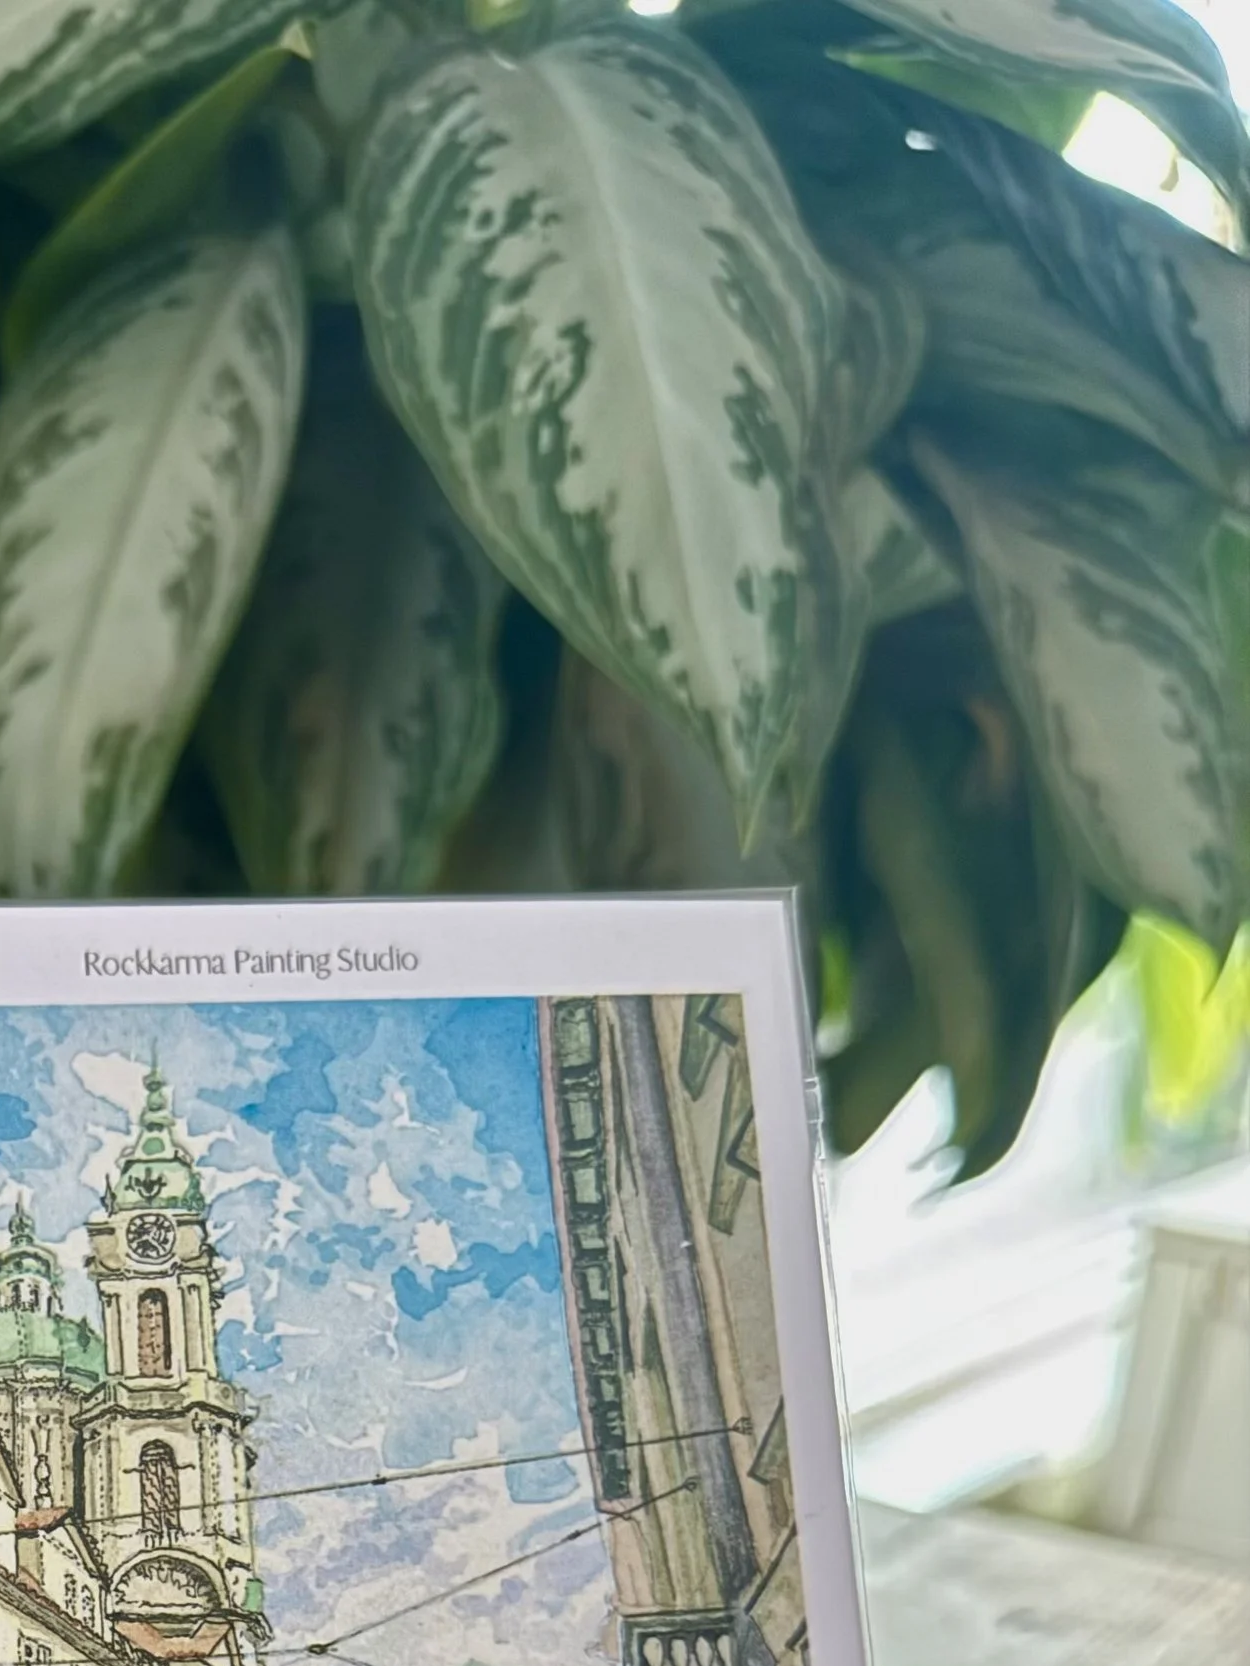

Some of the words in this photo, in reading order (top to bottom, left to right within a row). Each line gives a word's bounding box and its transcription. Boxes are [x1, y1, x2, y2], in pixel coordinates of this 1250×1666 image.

[83, 945, 226, 977] Rockkarma
[234, 946, 331, 981] Painting
[337, 944, 419, 973] Studio
